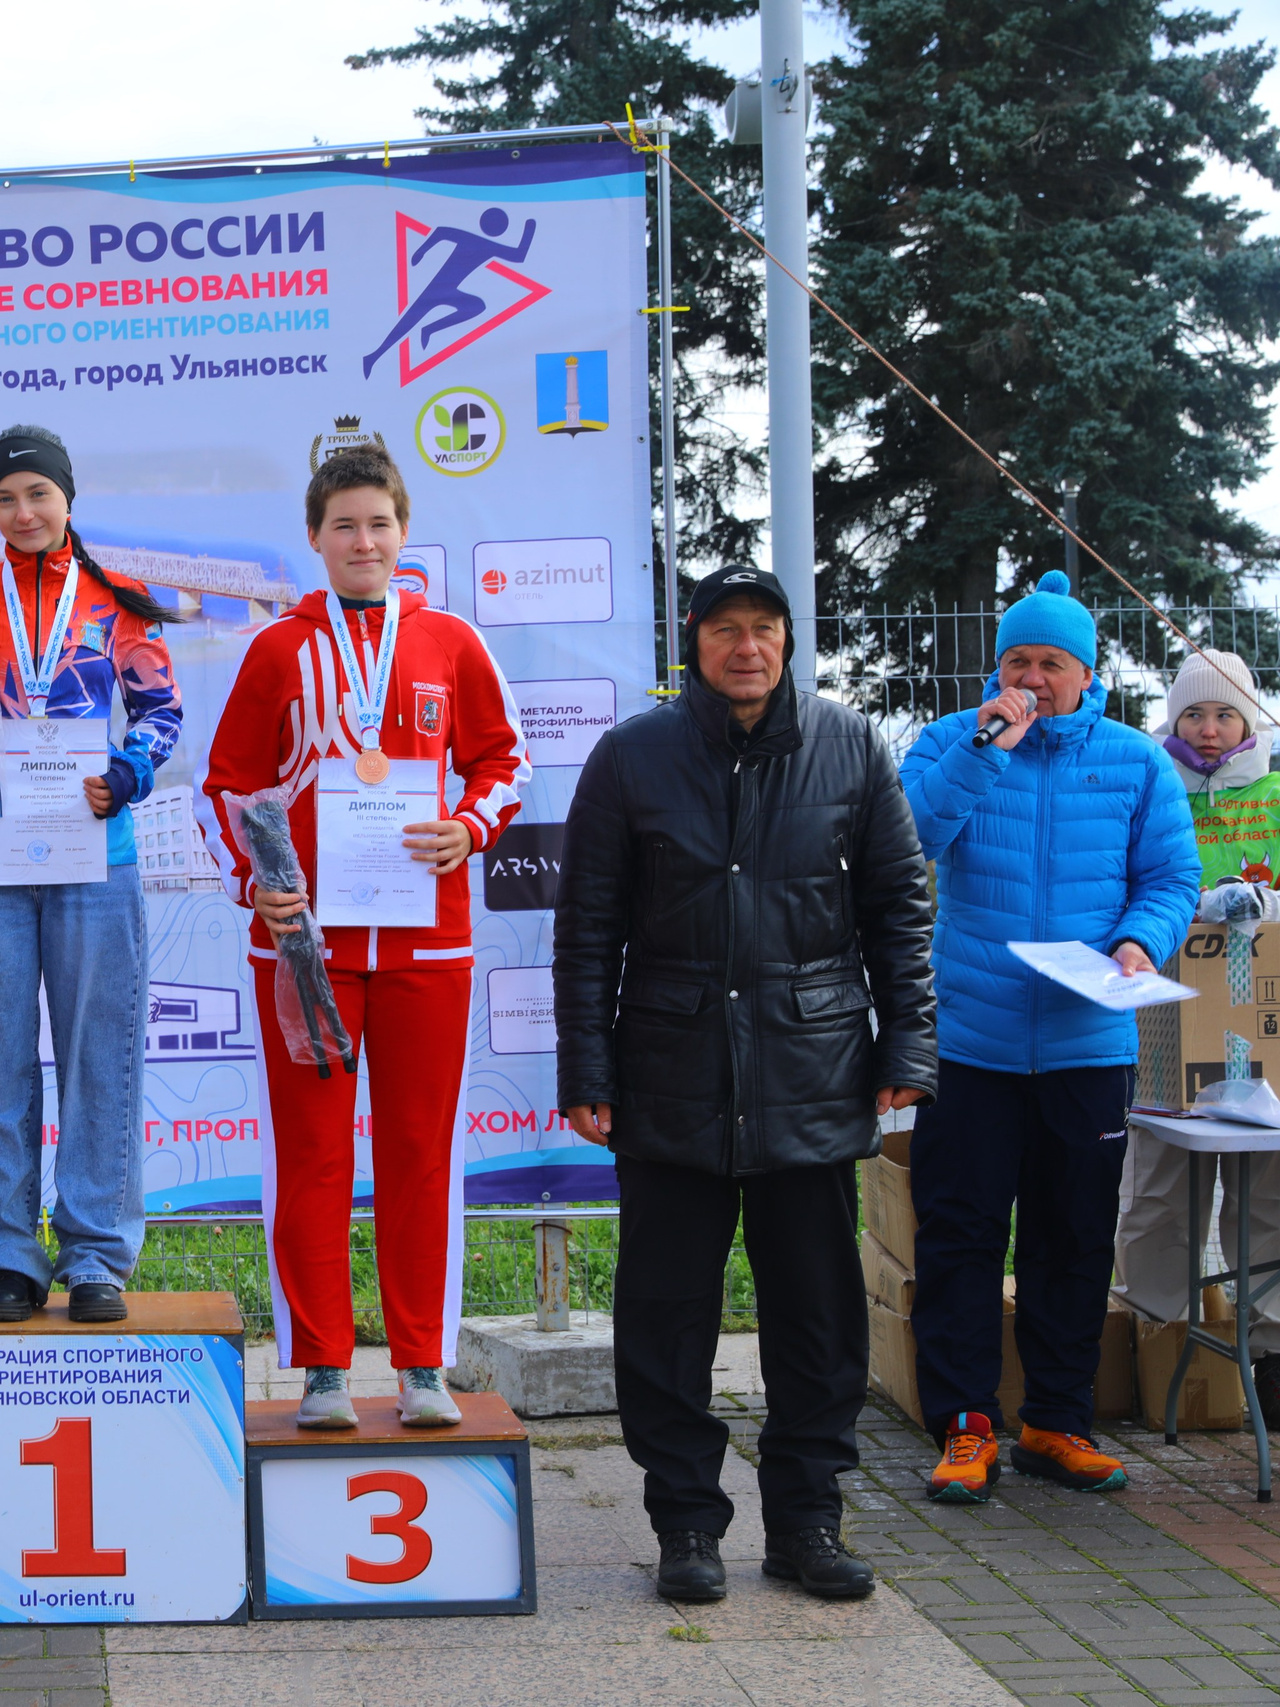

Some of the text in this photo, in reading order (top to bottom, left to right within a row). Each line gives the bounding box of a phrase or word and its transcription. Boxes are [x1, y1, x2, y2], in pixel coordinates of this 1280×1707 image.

[89, 211, 325, 265] РОССИИ
[23, 268, 329, 311] СОРЕВНОВАНИЯ
[72, 308, 330, 343] ОРИЕНТИРОВАНИЯ
[74, 363, 163, 391] город
[169, 354, 328, 381] Ульяновск
[326, 434, 370, 444] ТРИУМФ
[434, 451, 487, 464] УЛСПОРТ
[514, 563, 605, 586] azimut
[515, 592, 544, 601] ОТЕЛЬ
[9, 592, 21, 628] МИНИСТЕРСТВО
[21, 651, 30, 675] РОССИИ
[45, 631, 60, 675] МИНИСТЕРСТВО
[520, 705, 583, 717] МЕТАЛЛО
[521, 715, 614, 728] ПРОФИЛЬНЫЙ
[523, 730, 565, 740] ЗАВОД
[20, 761, 77, 773] ДИПЛОМ
[348, 801, 406, 812] ДИПЛОМ
[1214, 798, 1280, 812] ортивно
[1194, 814, 1267, 831] ирования
[1223, 828, 1280, 844] област
[173, 1118, 260, 1142] ПРОП
[466, 1110, 536, 1135] ХОМ
[63, 1347, 204, 1364] СПОРТИВНОГО
[101, 1389, 190, 1404] ОБЛАСТИ
[20, 1416, 127, 1578] 1
[345, 1468, 434, 1585] 3
[19, 1590, 136, 1607] ul-orient.ru
